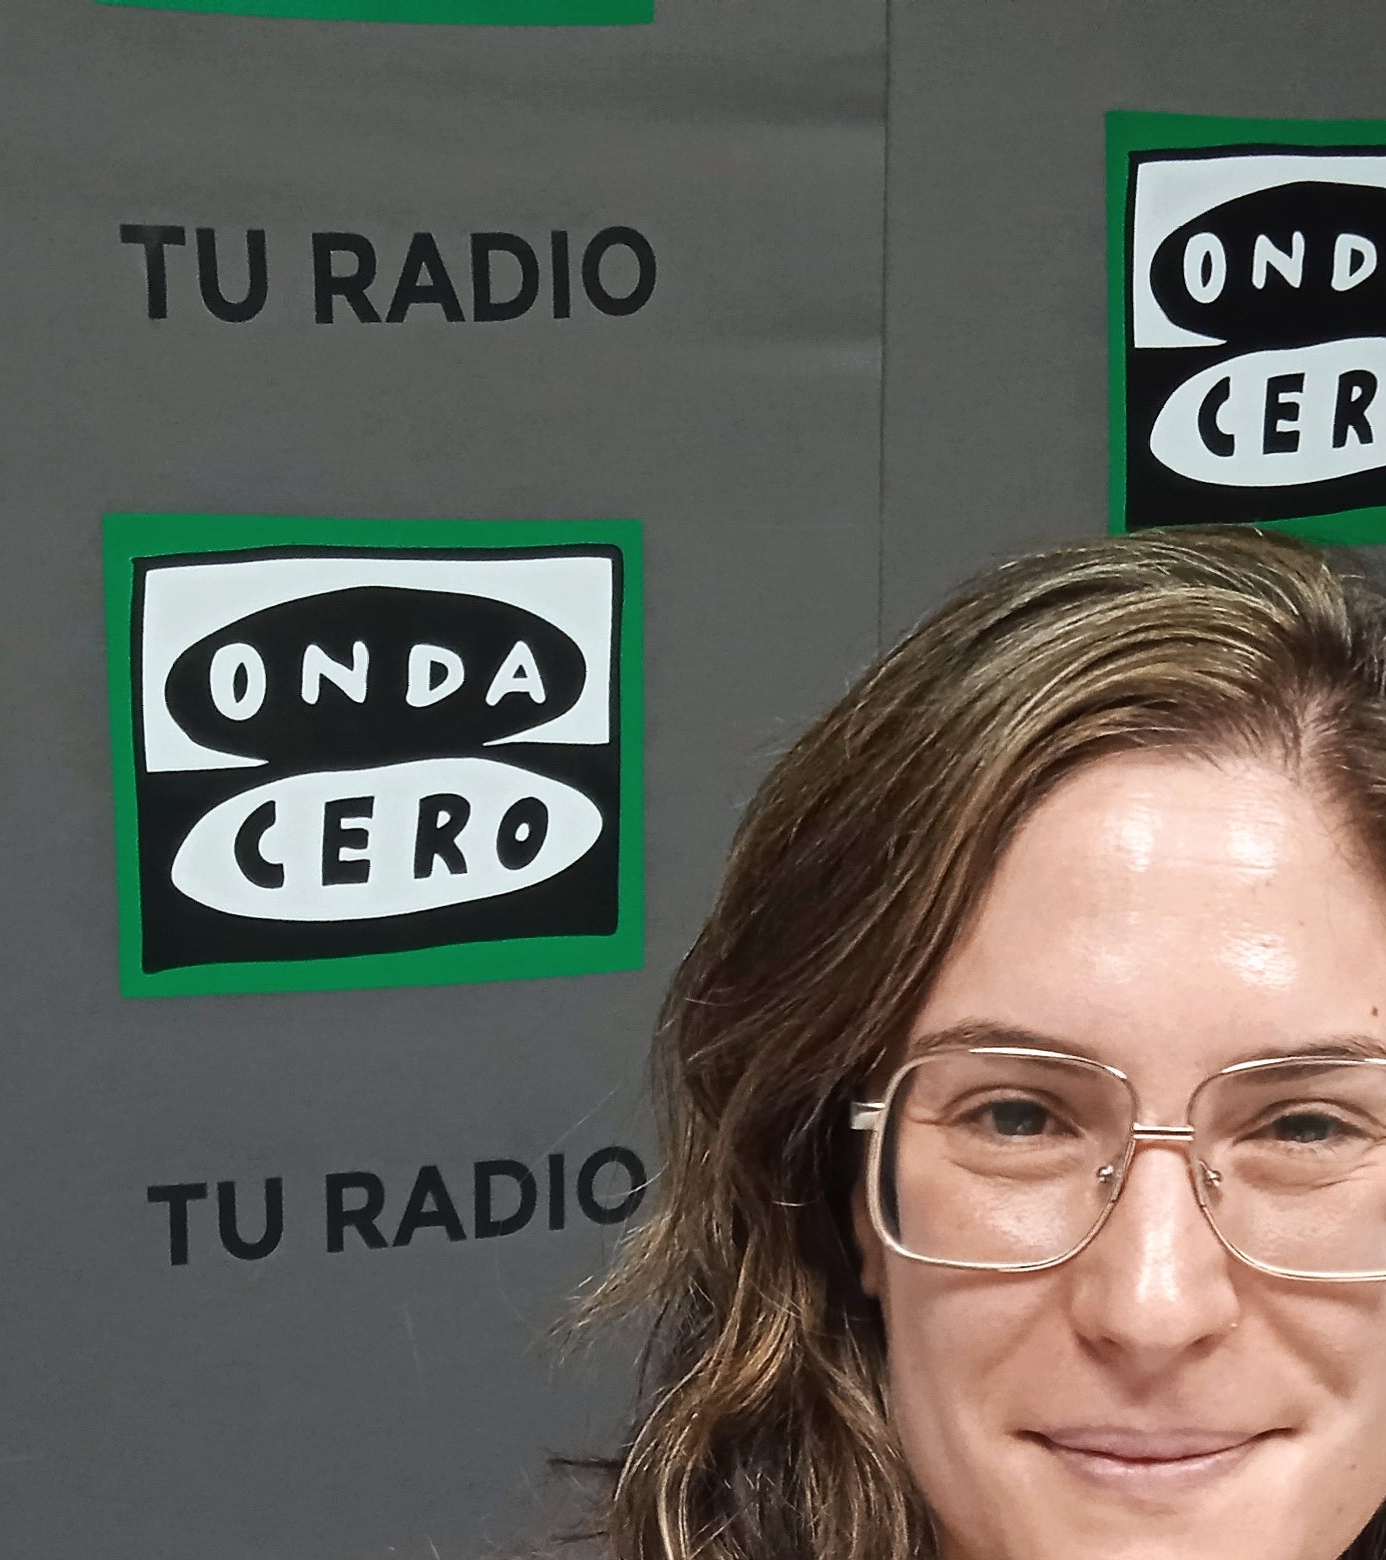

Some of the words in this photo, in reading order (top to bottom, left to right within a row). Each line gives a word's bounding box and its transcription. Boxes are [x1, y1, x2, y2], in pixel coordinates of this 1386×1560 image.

[120, 223, 269, 323] TU
[312, 226, 657, 324] RADIO
[210, 641, 545, 721] ONDA
[234, 793, 549, 889] CERO
[147, 1177, 284, 1266] TU
[325, 1145, 647, 1253] RADIO
